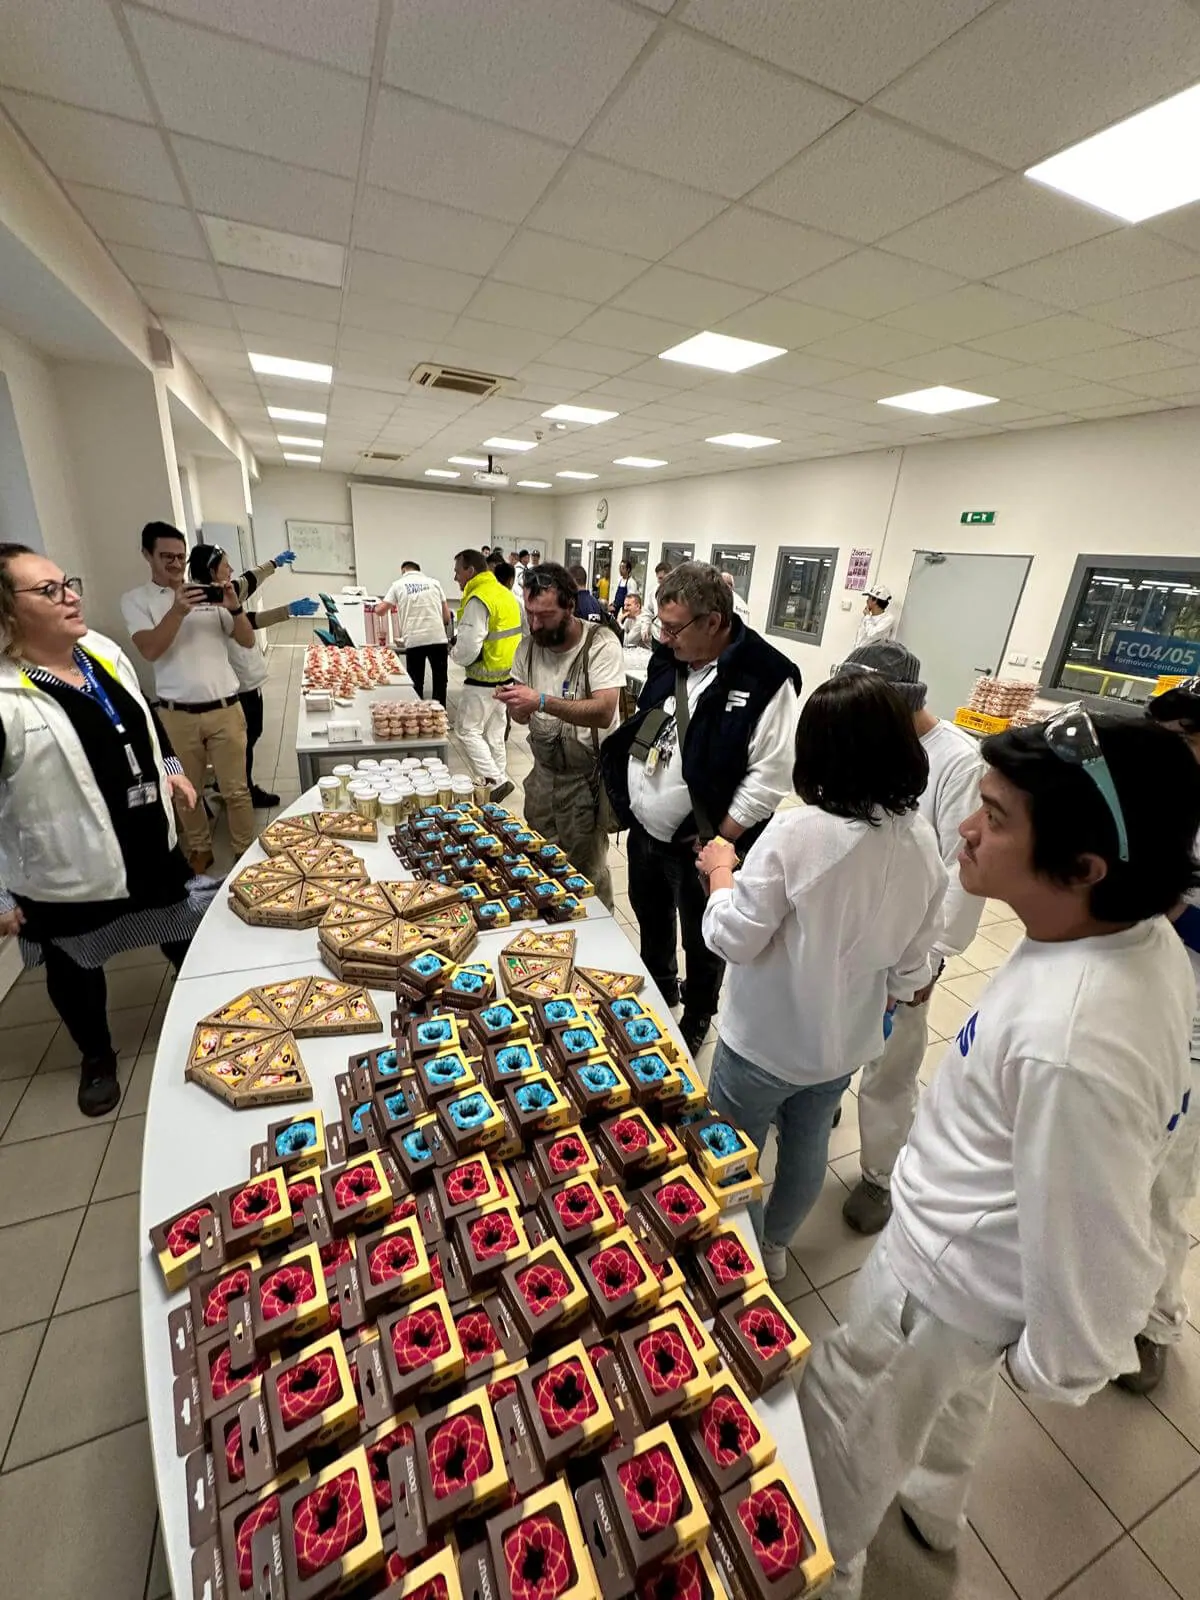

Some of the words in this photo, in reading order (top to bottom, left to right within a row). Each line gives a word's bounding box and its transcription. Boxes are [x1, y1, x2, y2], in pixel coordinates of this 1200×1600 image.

[1116, 641, 1196, 665] FC04/05
[637, 1211, 650, 1232] DONUT
[716, 1338, 733, 1362] DONUT
[613, 1362, 627, 1392] DONUT
[513, 1404, 526, 1435] DONUT
[406, 1456, 417, 1493] DONUT
[595, 1492, 611, 1532] DONUT
[214, 1547, 224, 1588] DONUT
[272, 1533, 283, 1576] DONUT
[714, 1532, 734, 1572] DONUT
[478, 1558, 492, 1600] DONUT
